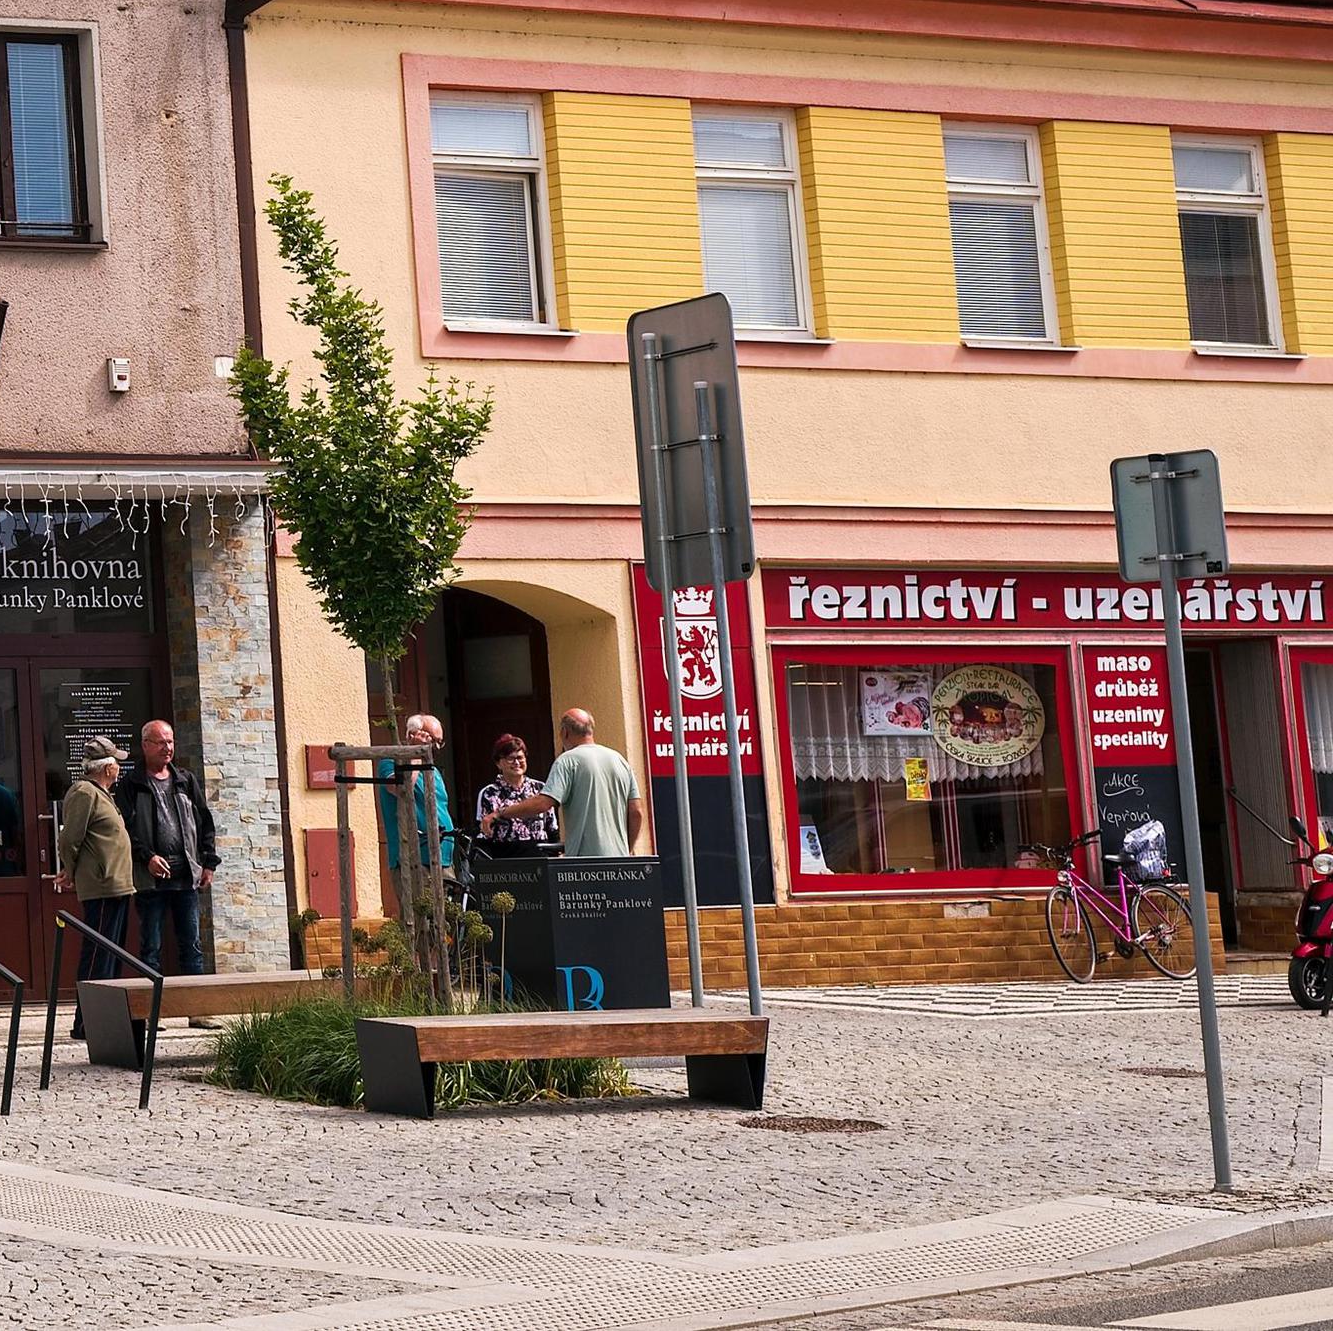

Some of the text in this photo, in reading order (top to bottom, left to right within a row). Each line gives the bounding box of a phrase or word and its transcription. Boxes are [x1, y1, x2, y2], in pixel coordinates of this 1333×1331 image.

[0, 547, 142, 579] knihovna
[53, 586, 144, 608] Panklové
[788, 575, 1017, 621] řeznictví
[1096, 654, 1152, 673] maso
[1094, 678, 1159, 698] drůběž
[1092, 706, 1165, 727] uzeniny
[1093, 730, 1169, 751] speciality
[559, 891, 607, 901] knihovna
[560, 898, 652, 910] Barunky Panklové
